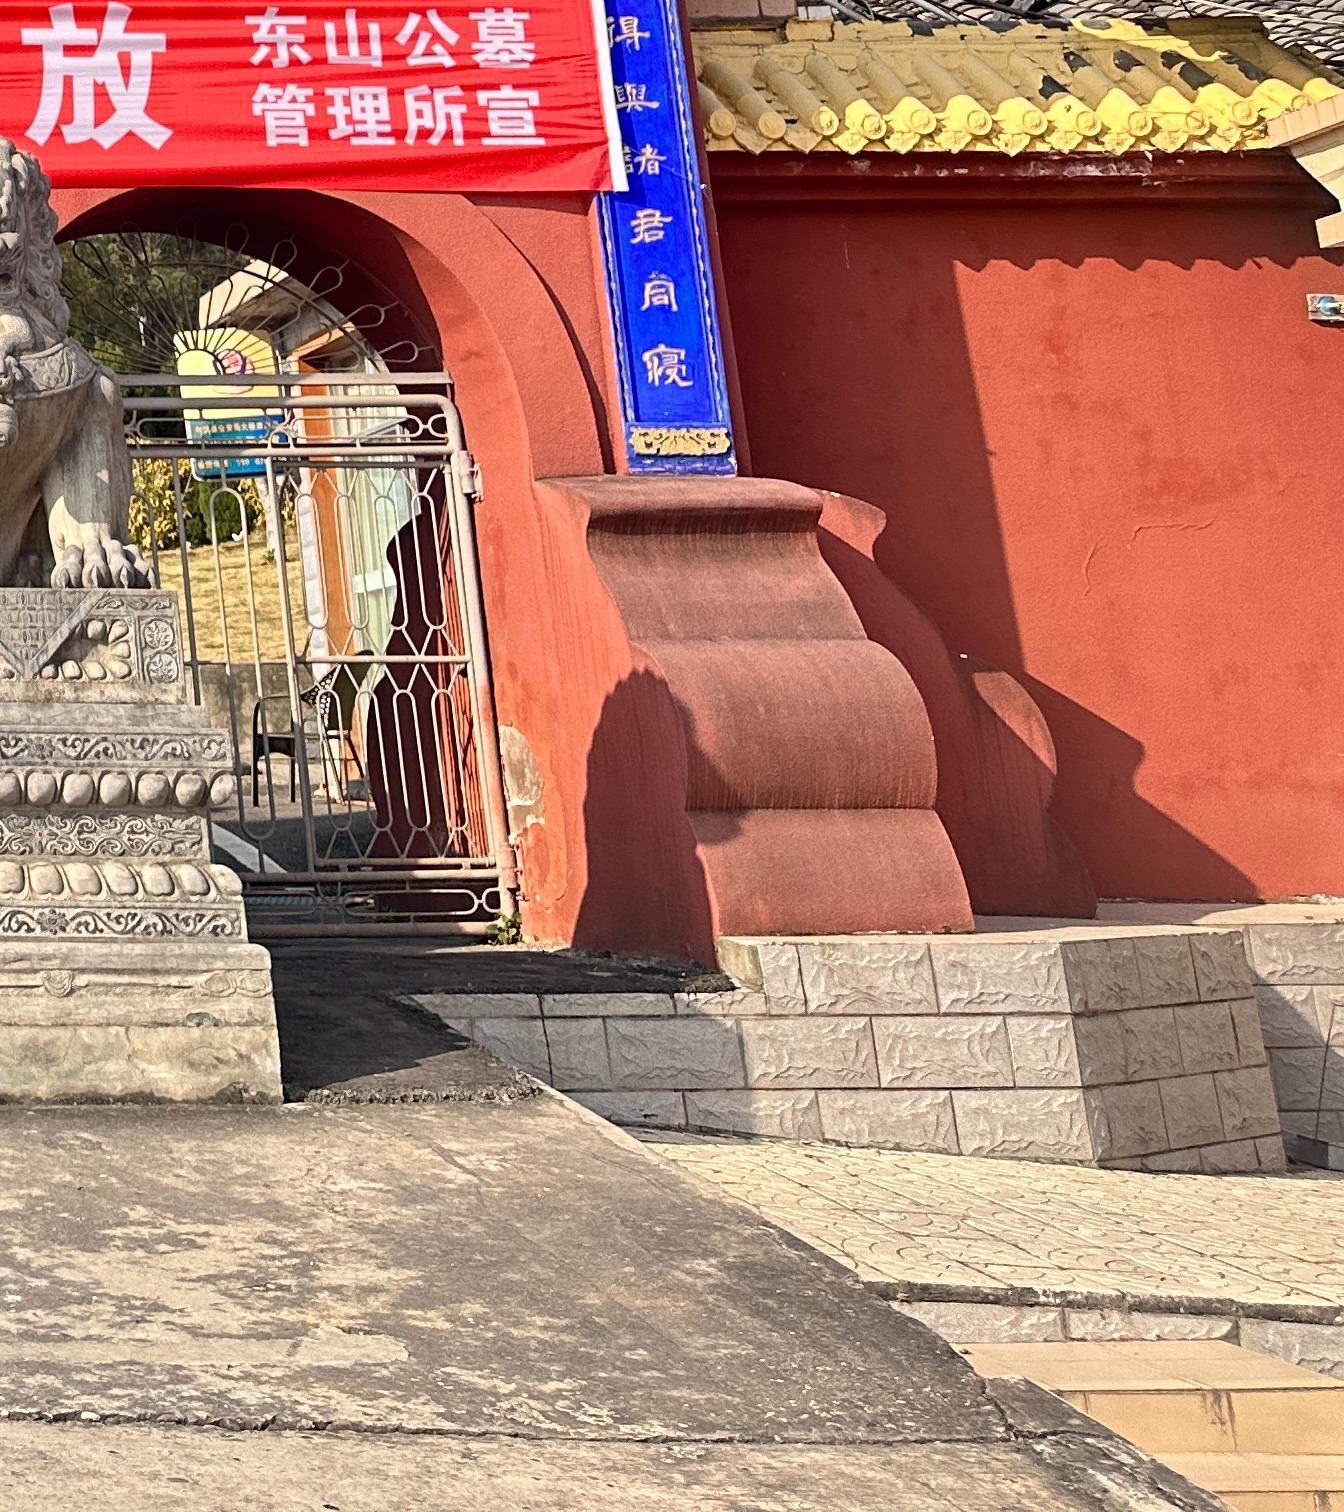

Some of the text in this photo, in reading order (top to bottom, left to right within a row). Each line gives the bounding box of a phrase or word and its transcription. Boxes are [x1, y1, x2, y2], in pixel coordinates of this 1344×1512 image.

[243, 7, 536, 69] 东山公墓
[251, 82, 546, 147] 管理所宣
